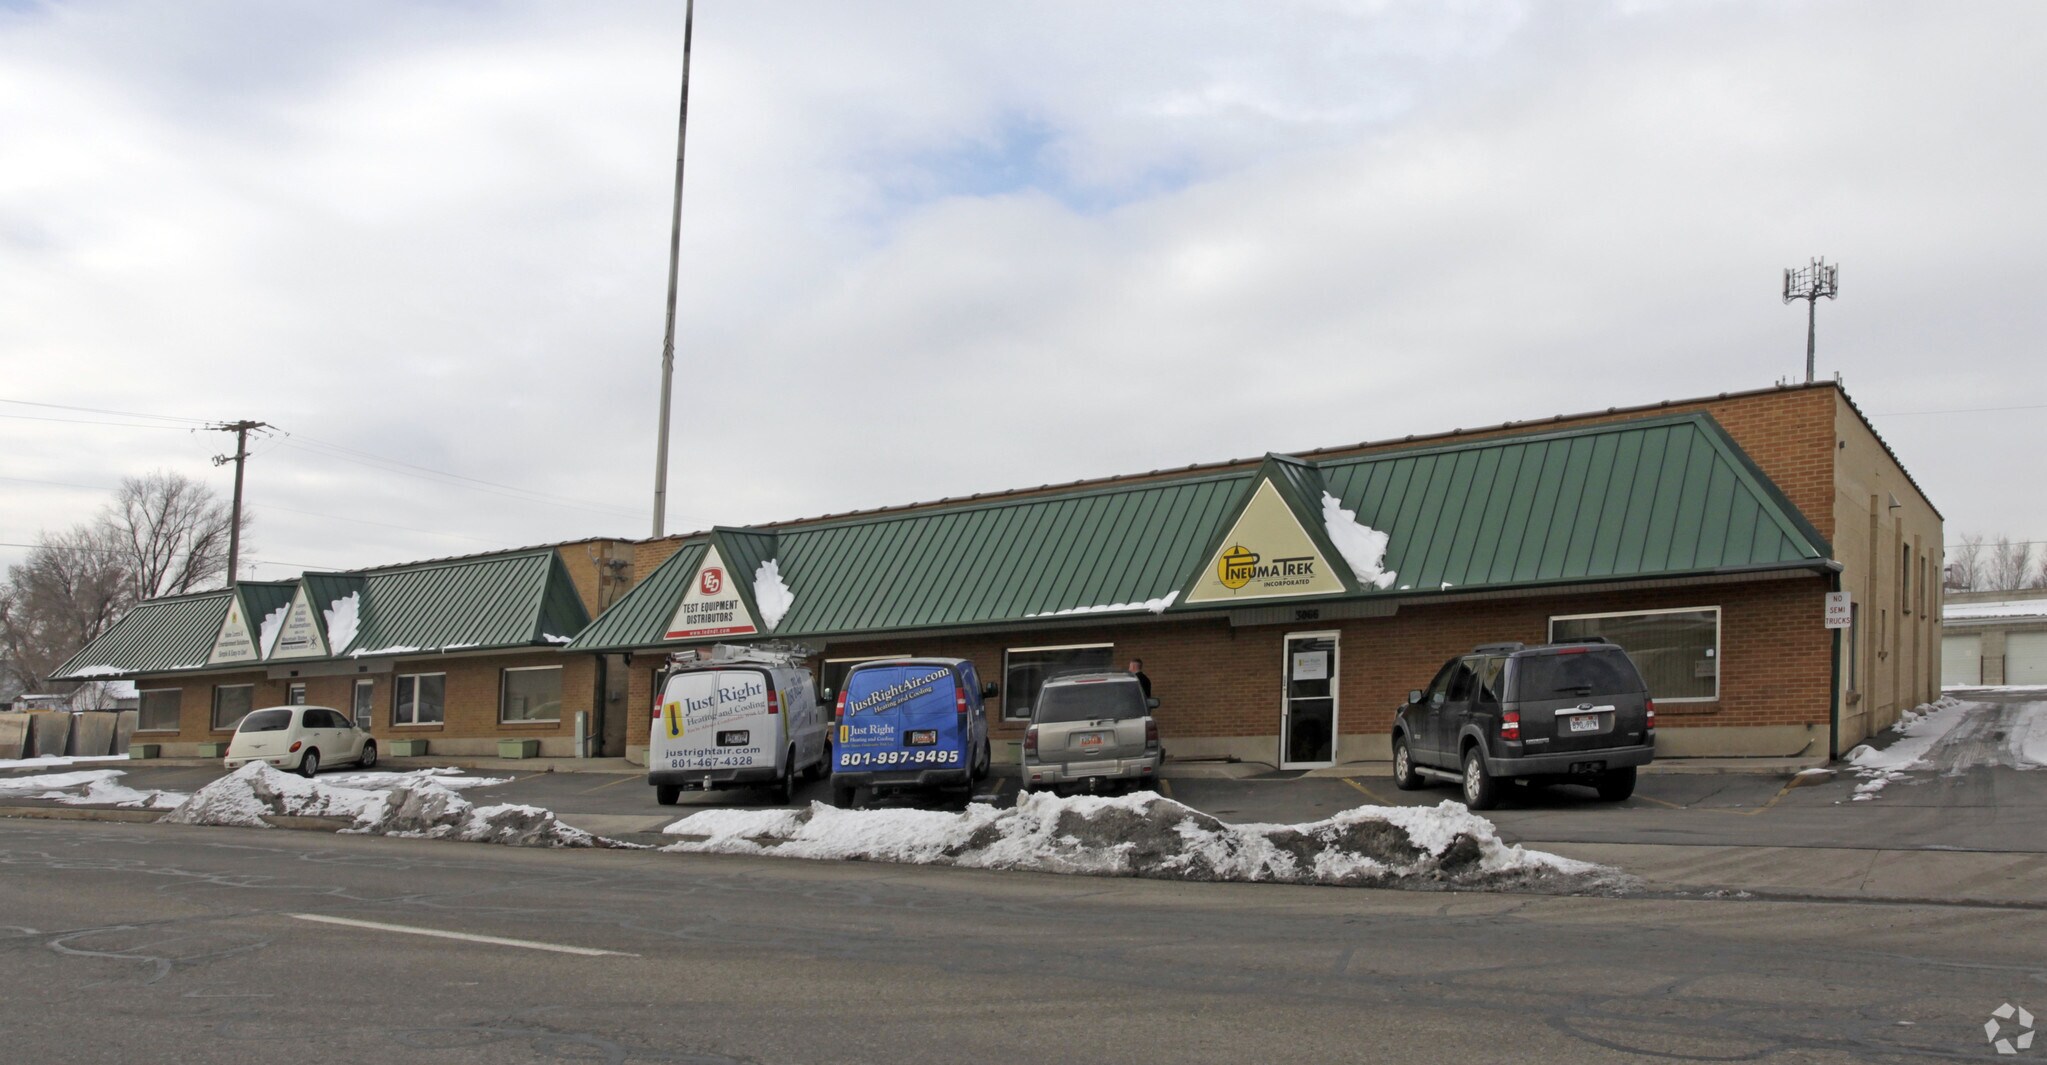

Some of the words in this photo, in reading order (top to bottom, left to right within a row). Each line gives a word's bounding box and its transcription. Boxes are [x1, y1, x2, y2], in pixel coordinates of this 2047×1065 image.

[703, 571, 720, 592] TED
[1263, 579, 1310, 587] INCORPORATED
[683, 602, 699, 613] TEST
[701, 599, 739, 612] EQUIPMENT
[686, 611, 733, 625] DISTRIBUTORS
[684, 695, 715, 717] Just
[717, 682, 762, 704] Right
[849, 667, 950, 717] JustRightAir.com
[873, 700, 897, 714] Heating
[897, 695, 909, 705] and
[908, 686, 933, 699] Cooling
[687, 712, 718, 726] Heating
[718, 707, 733, 718] and
[734, 700, 766, 713] Cooling
[849, 725, 867, 737] Just
[869, 723, 894, 736] Right
[665, 747, 761, 758] justrightair.com
[840, 750, 959, 766] 801-997-9495
[671, 756, 753, 768] 801-467-4328
